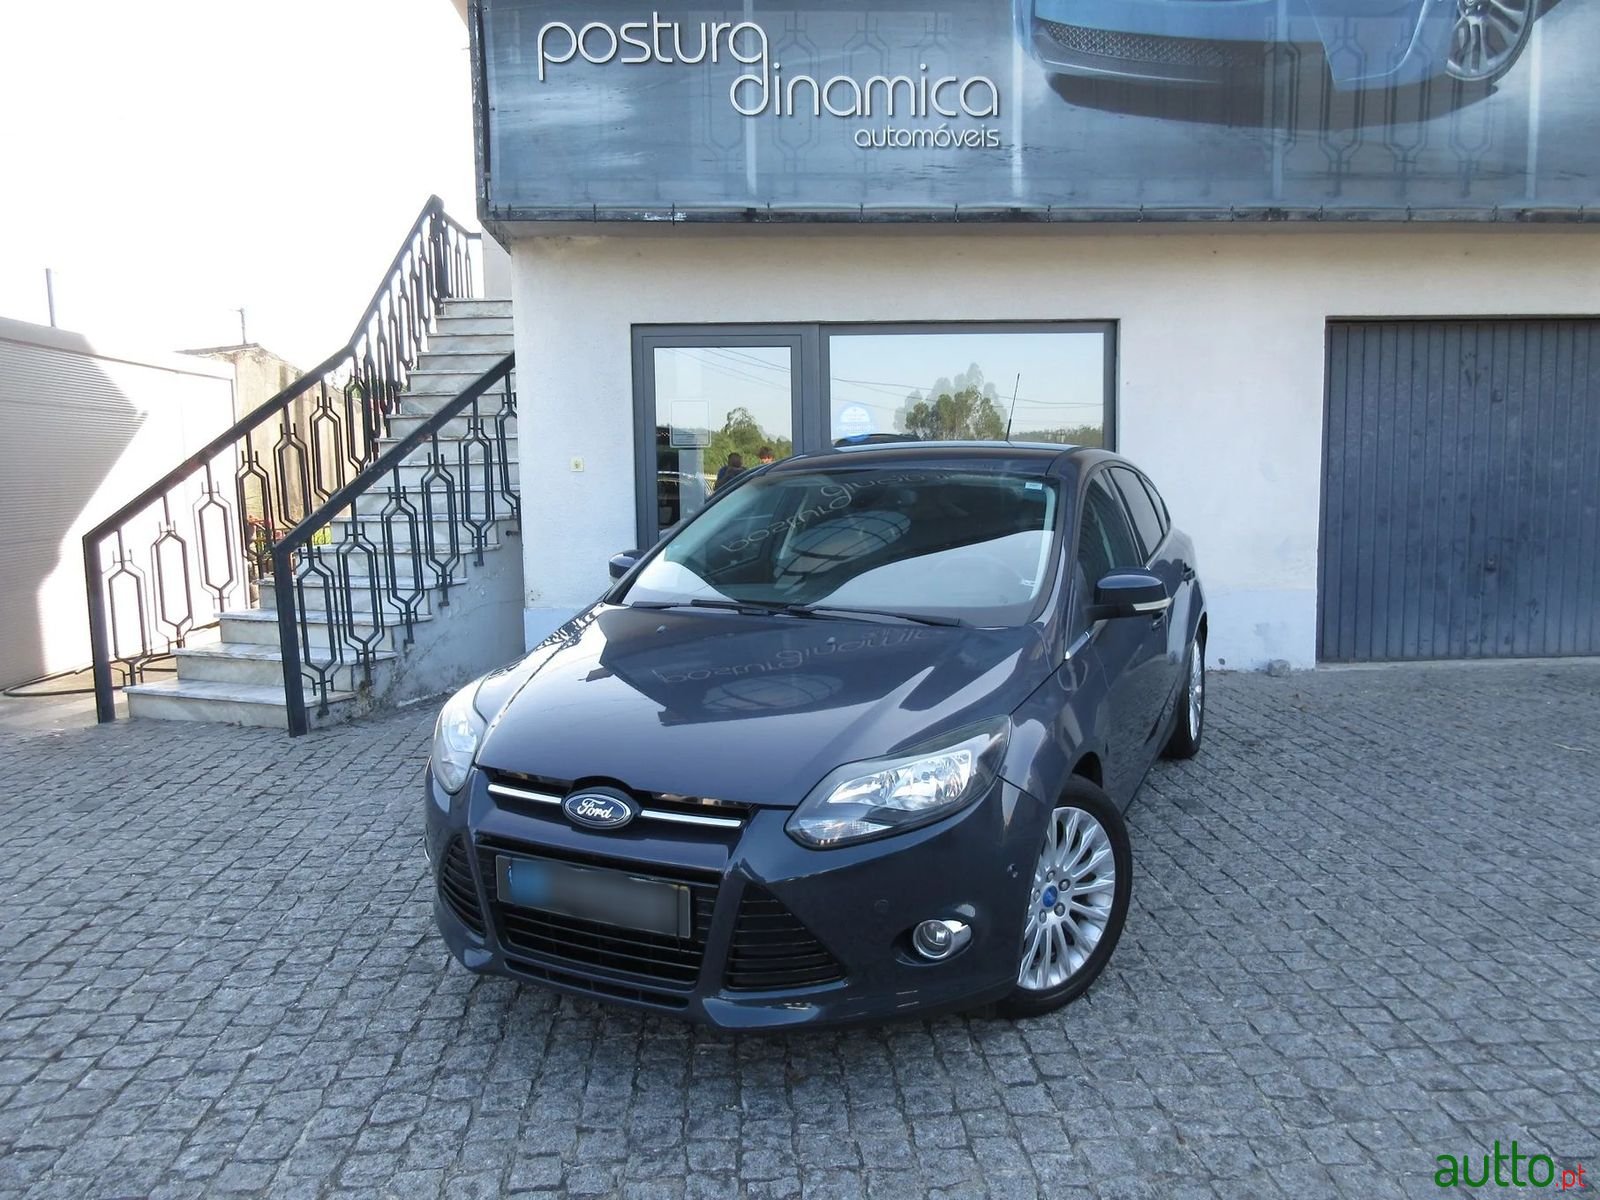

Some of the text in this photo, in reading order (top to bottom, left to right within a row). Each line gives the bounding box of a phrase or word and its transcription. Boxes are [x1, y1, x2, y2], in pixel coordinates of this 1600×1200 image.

[537, 11, 769, 82] postura
[729, 62, 1000, 117] dinamica
[853, 123, 1000, 149] automóveis
[577, 798, 613, 819] Ford
